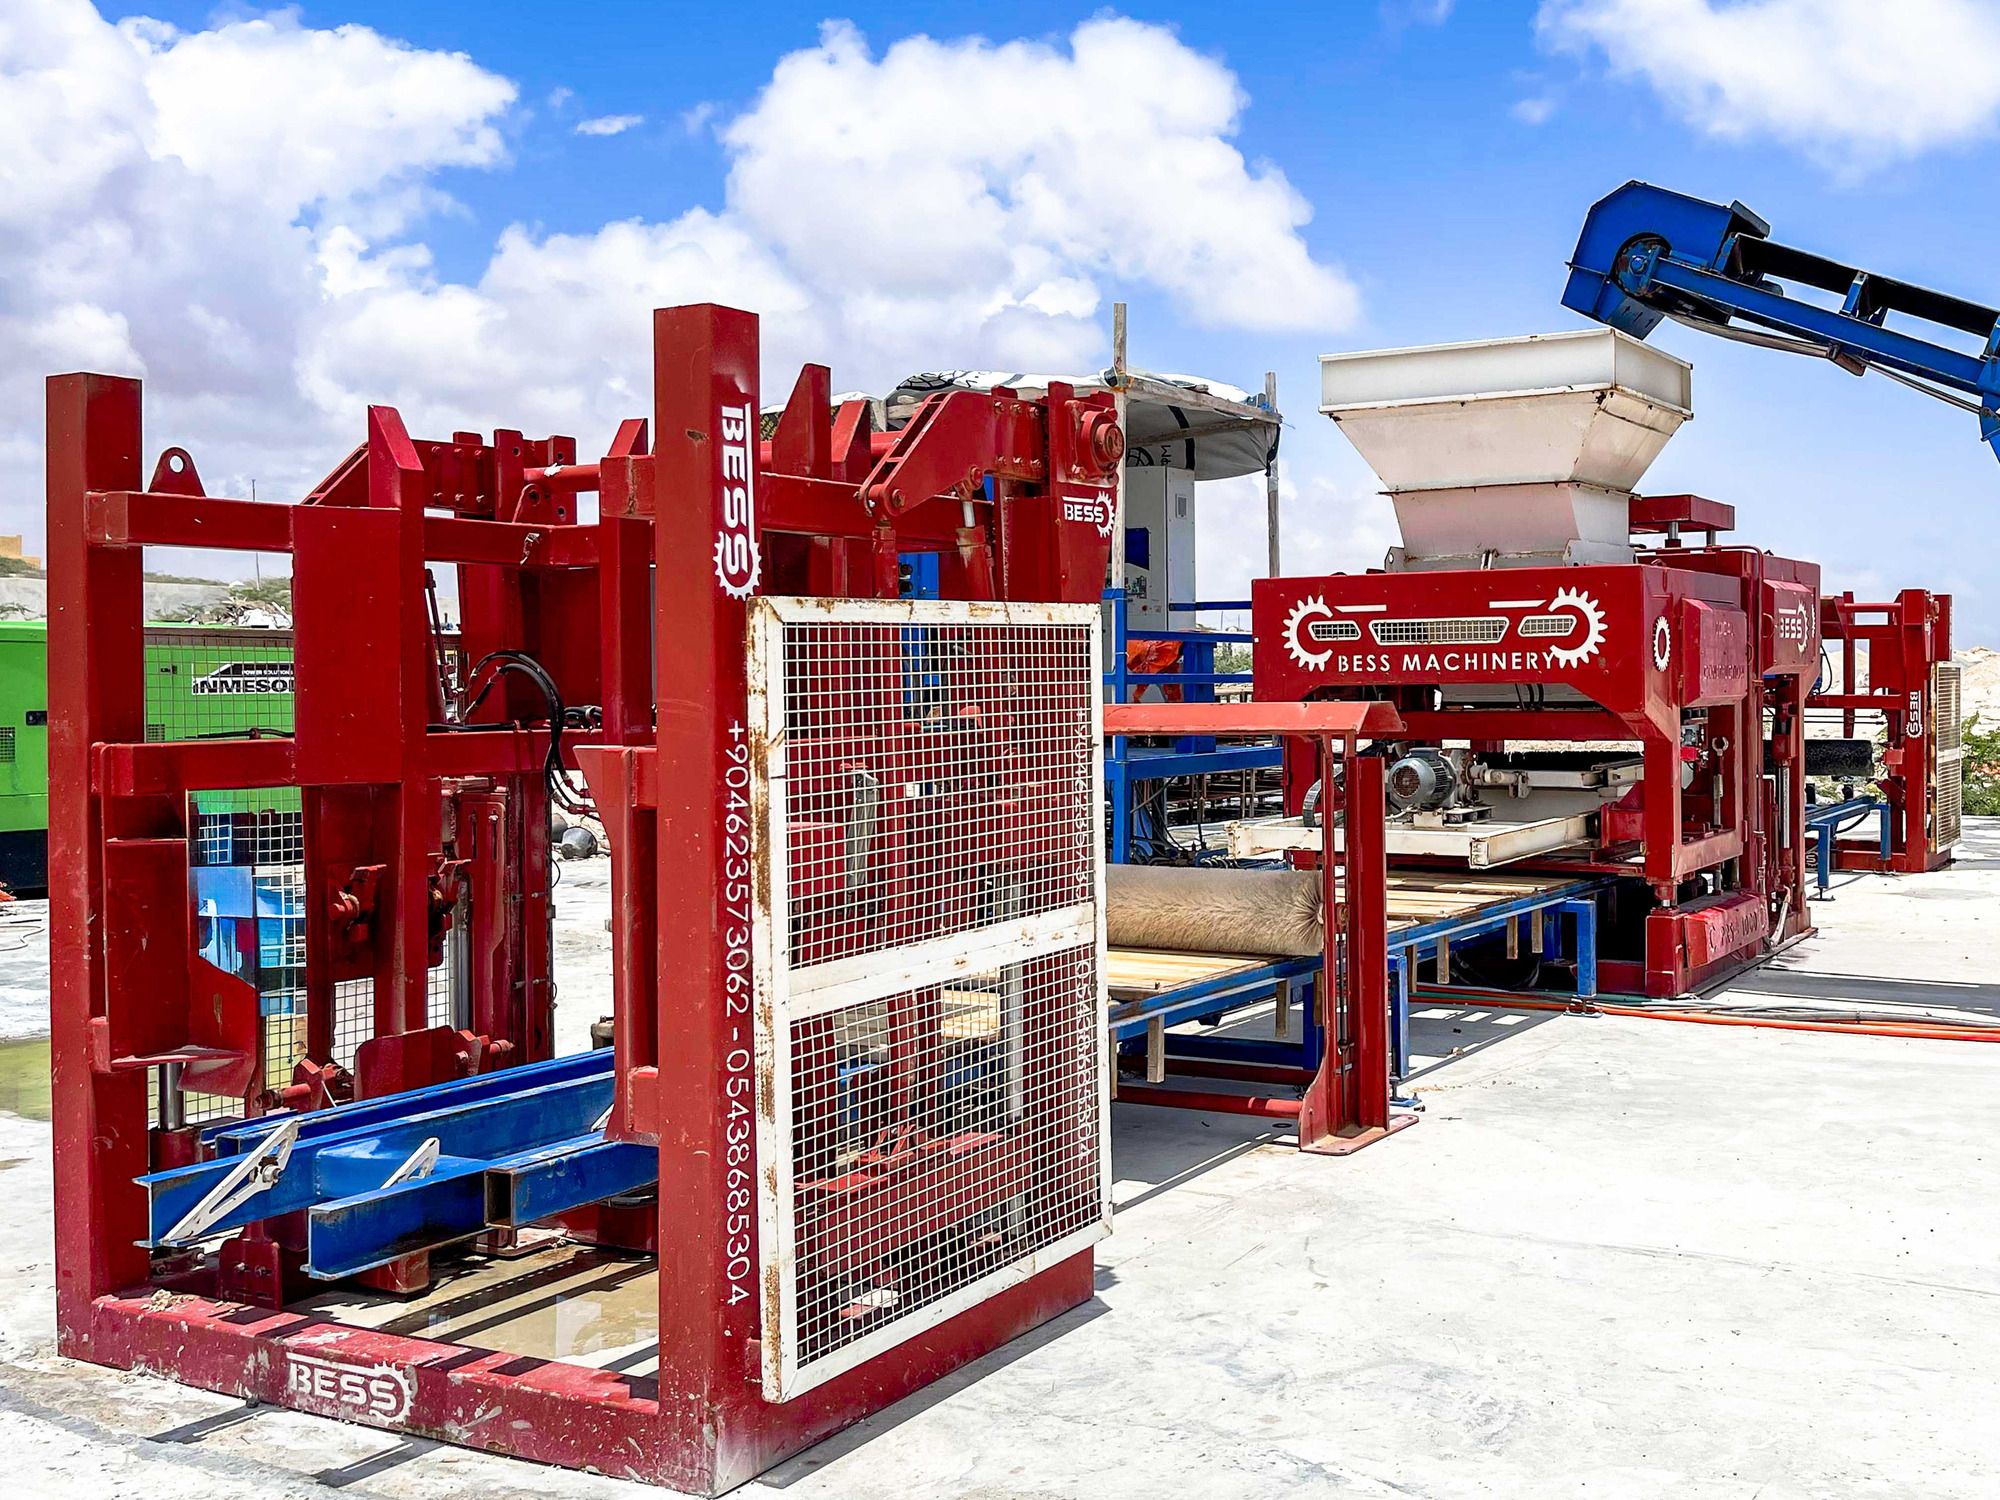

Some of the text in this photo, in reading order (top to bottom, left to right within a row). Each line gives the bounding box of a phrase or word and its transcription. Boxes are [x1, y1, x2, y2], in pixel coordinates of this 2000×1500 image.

[721, 405, 748, 576] BESS
[1063, 503, 1105, 523] BESS
[1779, 617, 1801, 639] BESS
[1338, 651, 1554, 672] BESS MACHINERY
[1909, 691, 1919, 733] BESS
[725, 720, 749, 1018] +904623573062
[726, 1049, 750, 1306] 05438685304
[287, 1362, 397, 1411] BESS
